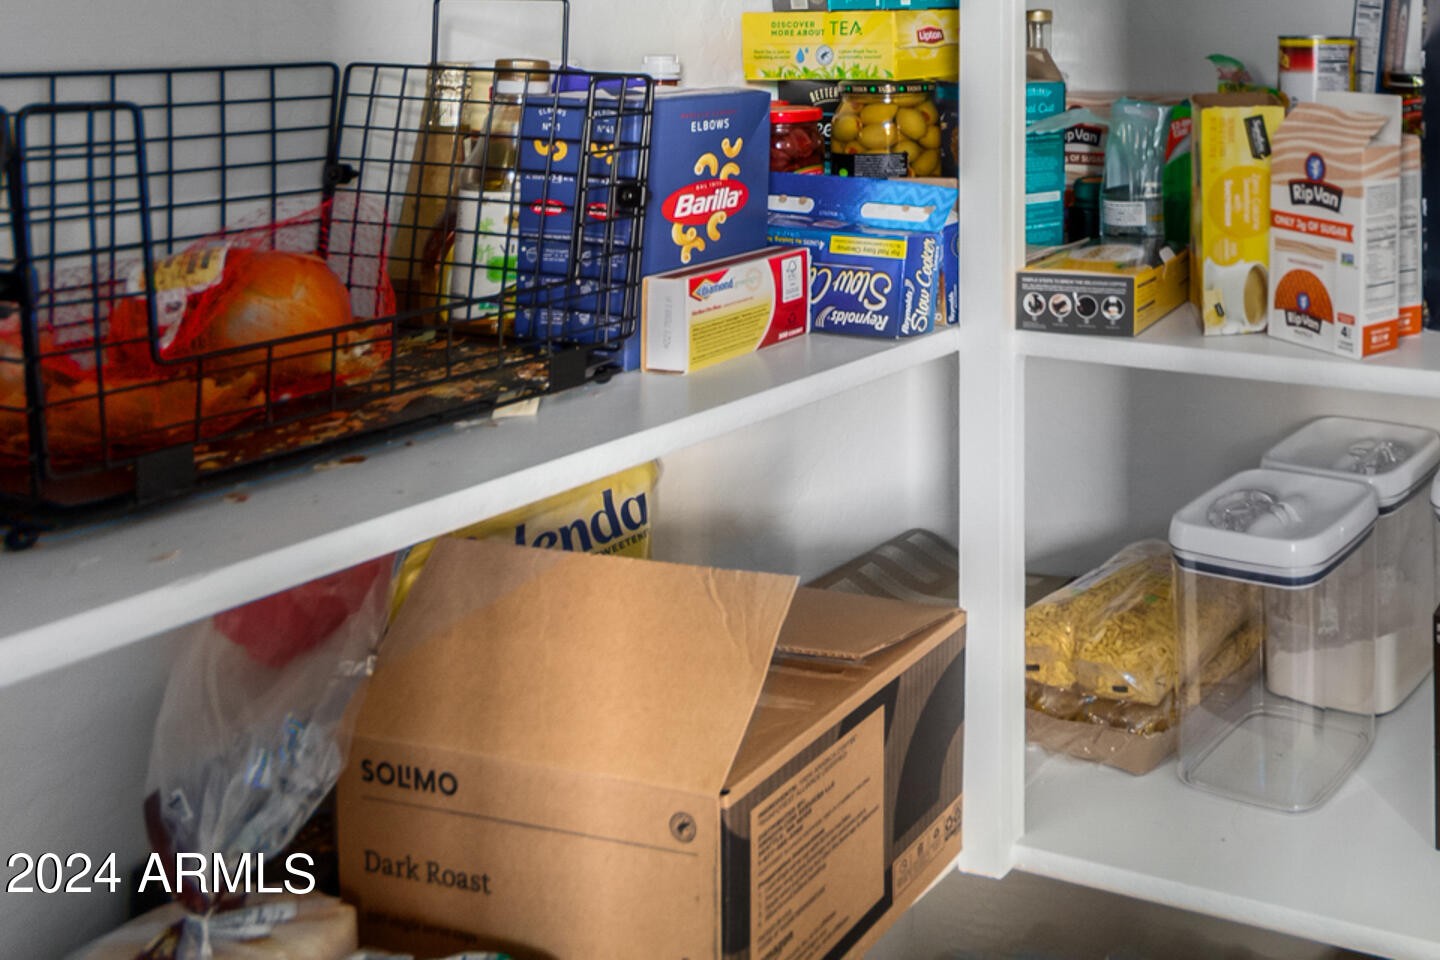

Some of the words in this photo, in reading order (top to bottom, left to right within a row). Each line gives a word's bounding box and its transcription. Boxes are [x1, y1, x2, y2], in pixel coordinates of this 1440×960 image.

[770, 21, 816, 29] DISCOVER
[770, 29, 795, 37] MORE
[797, 29, 825, 37] ABOUT
[829, 20, 864, 37] TEA
[917, 29, 943, 42] Lipton
[690, 117, 730, 132] ELBOWS
[673, 187, 743, 218] Barilla
[833, 270, 892, 312] Slow
[830, 310, 889, 332] Reynolds
[360, 759, 459, 797] SOLIMO
[363, 849, 420, 882] Dark
[426, 861, 492, 896] Roast
